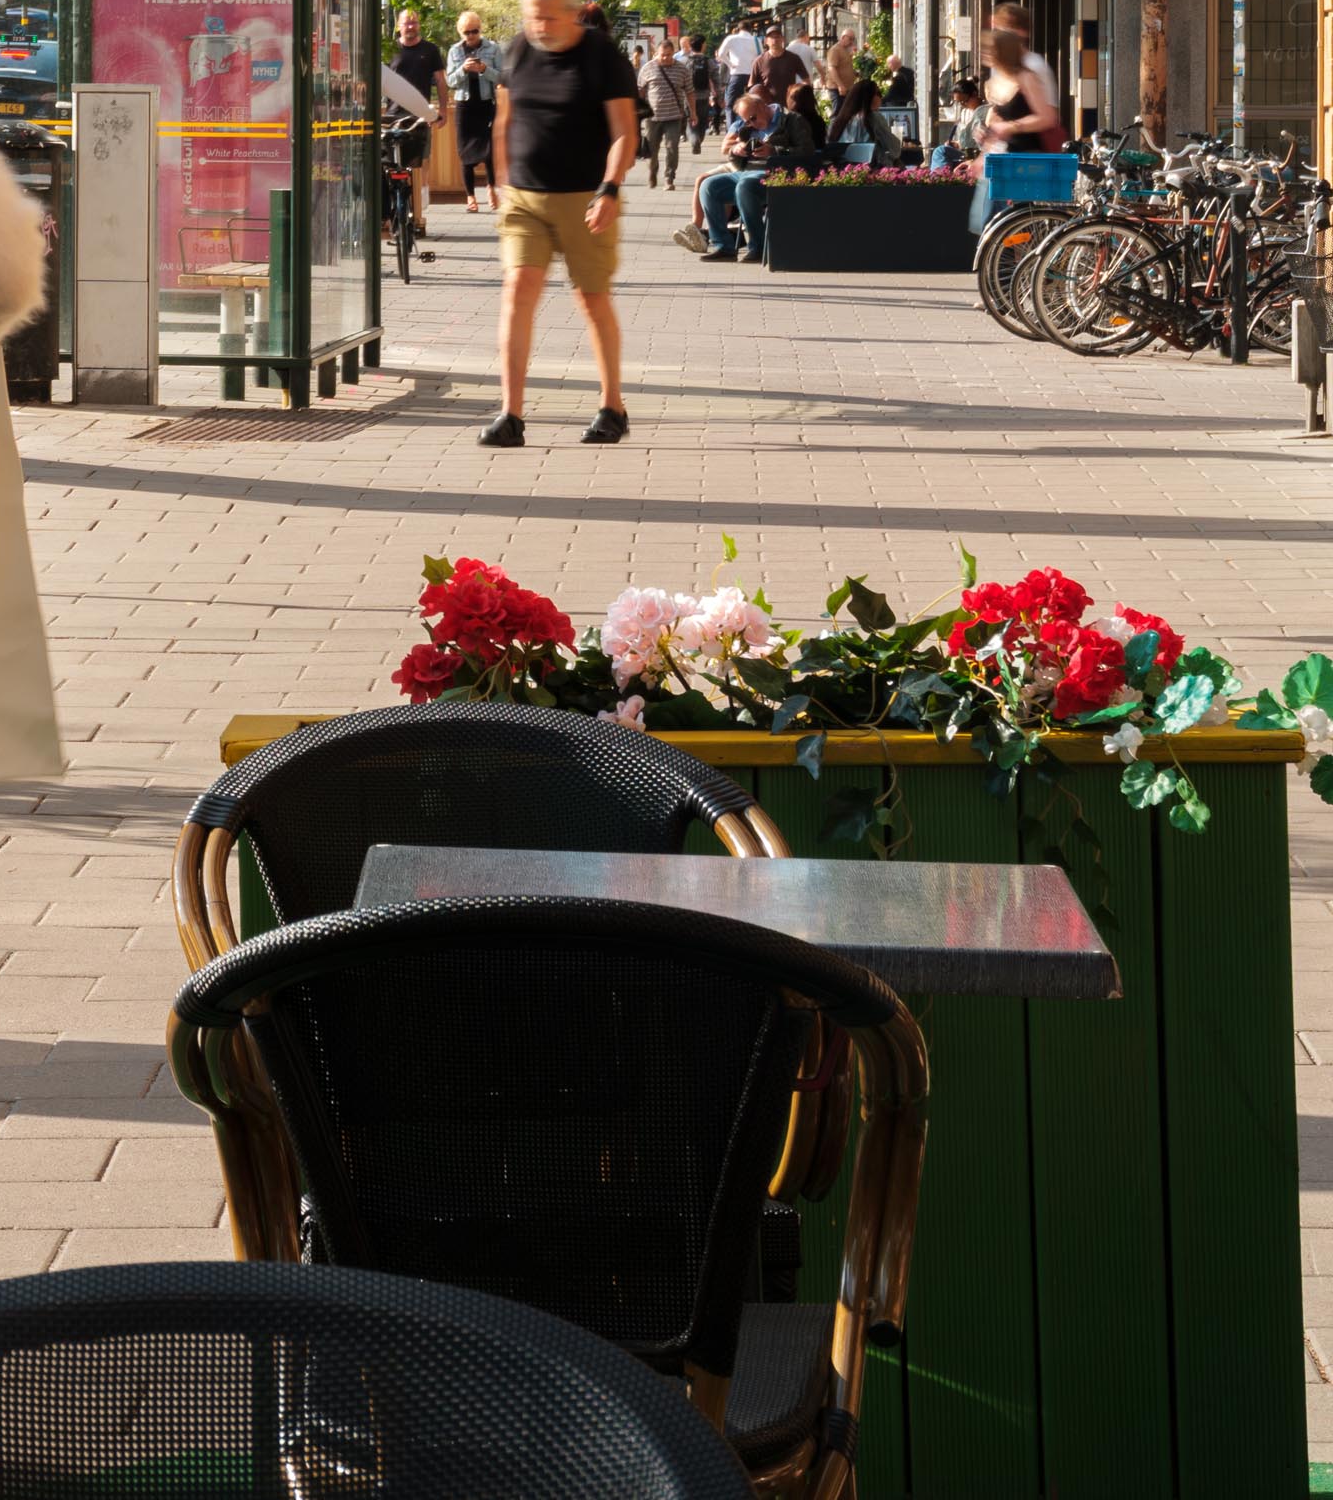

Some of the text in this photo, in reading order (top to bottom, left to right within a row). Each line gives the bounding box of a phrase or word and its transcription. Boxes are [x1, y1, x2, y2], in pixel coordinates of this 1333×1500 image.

[253, 66, 279, 77] NYHET
[206, 148, 280, 158] White Peachsmak
